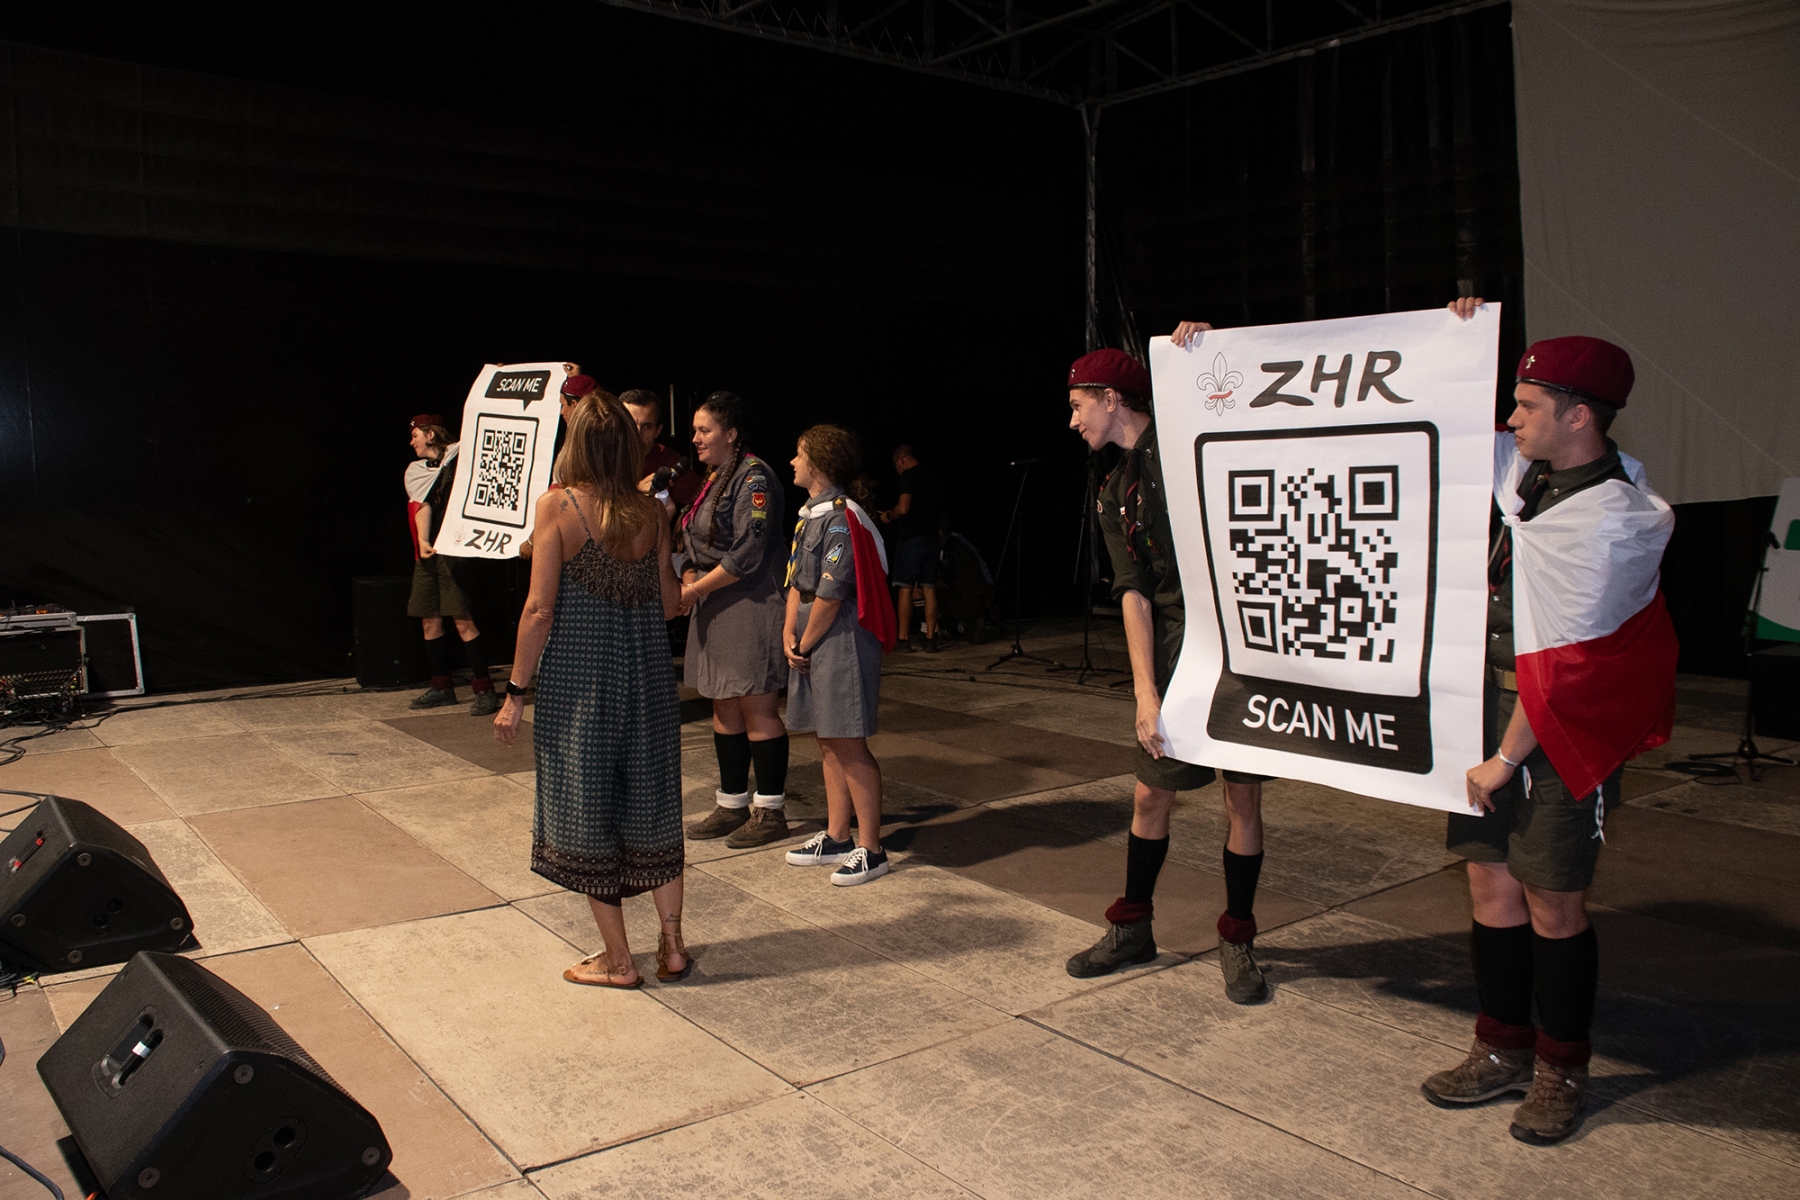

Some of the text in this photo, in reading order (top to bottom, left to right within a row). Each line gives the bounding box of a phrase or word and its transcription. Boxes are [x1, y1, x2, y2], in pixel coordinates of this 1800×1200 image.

[496, 377, 543, 393] SCAN ME
[1249, 350, 1415, 408] ZHR
[464, 528, 513, 555] ZHR
[1242, 694, 1399, 751] SCAN ME
